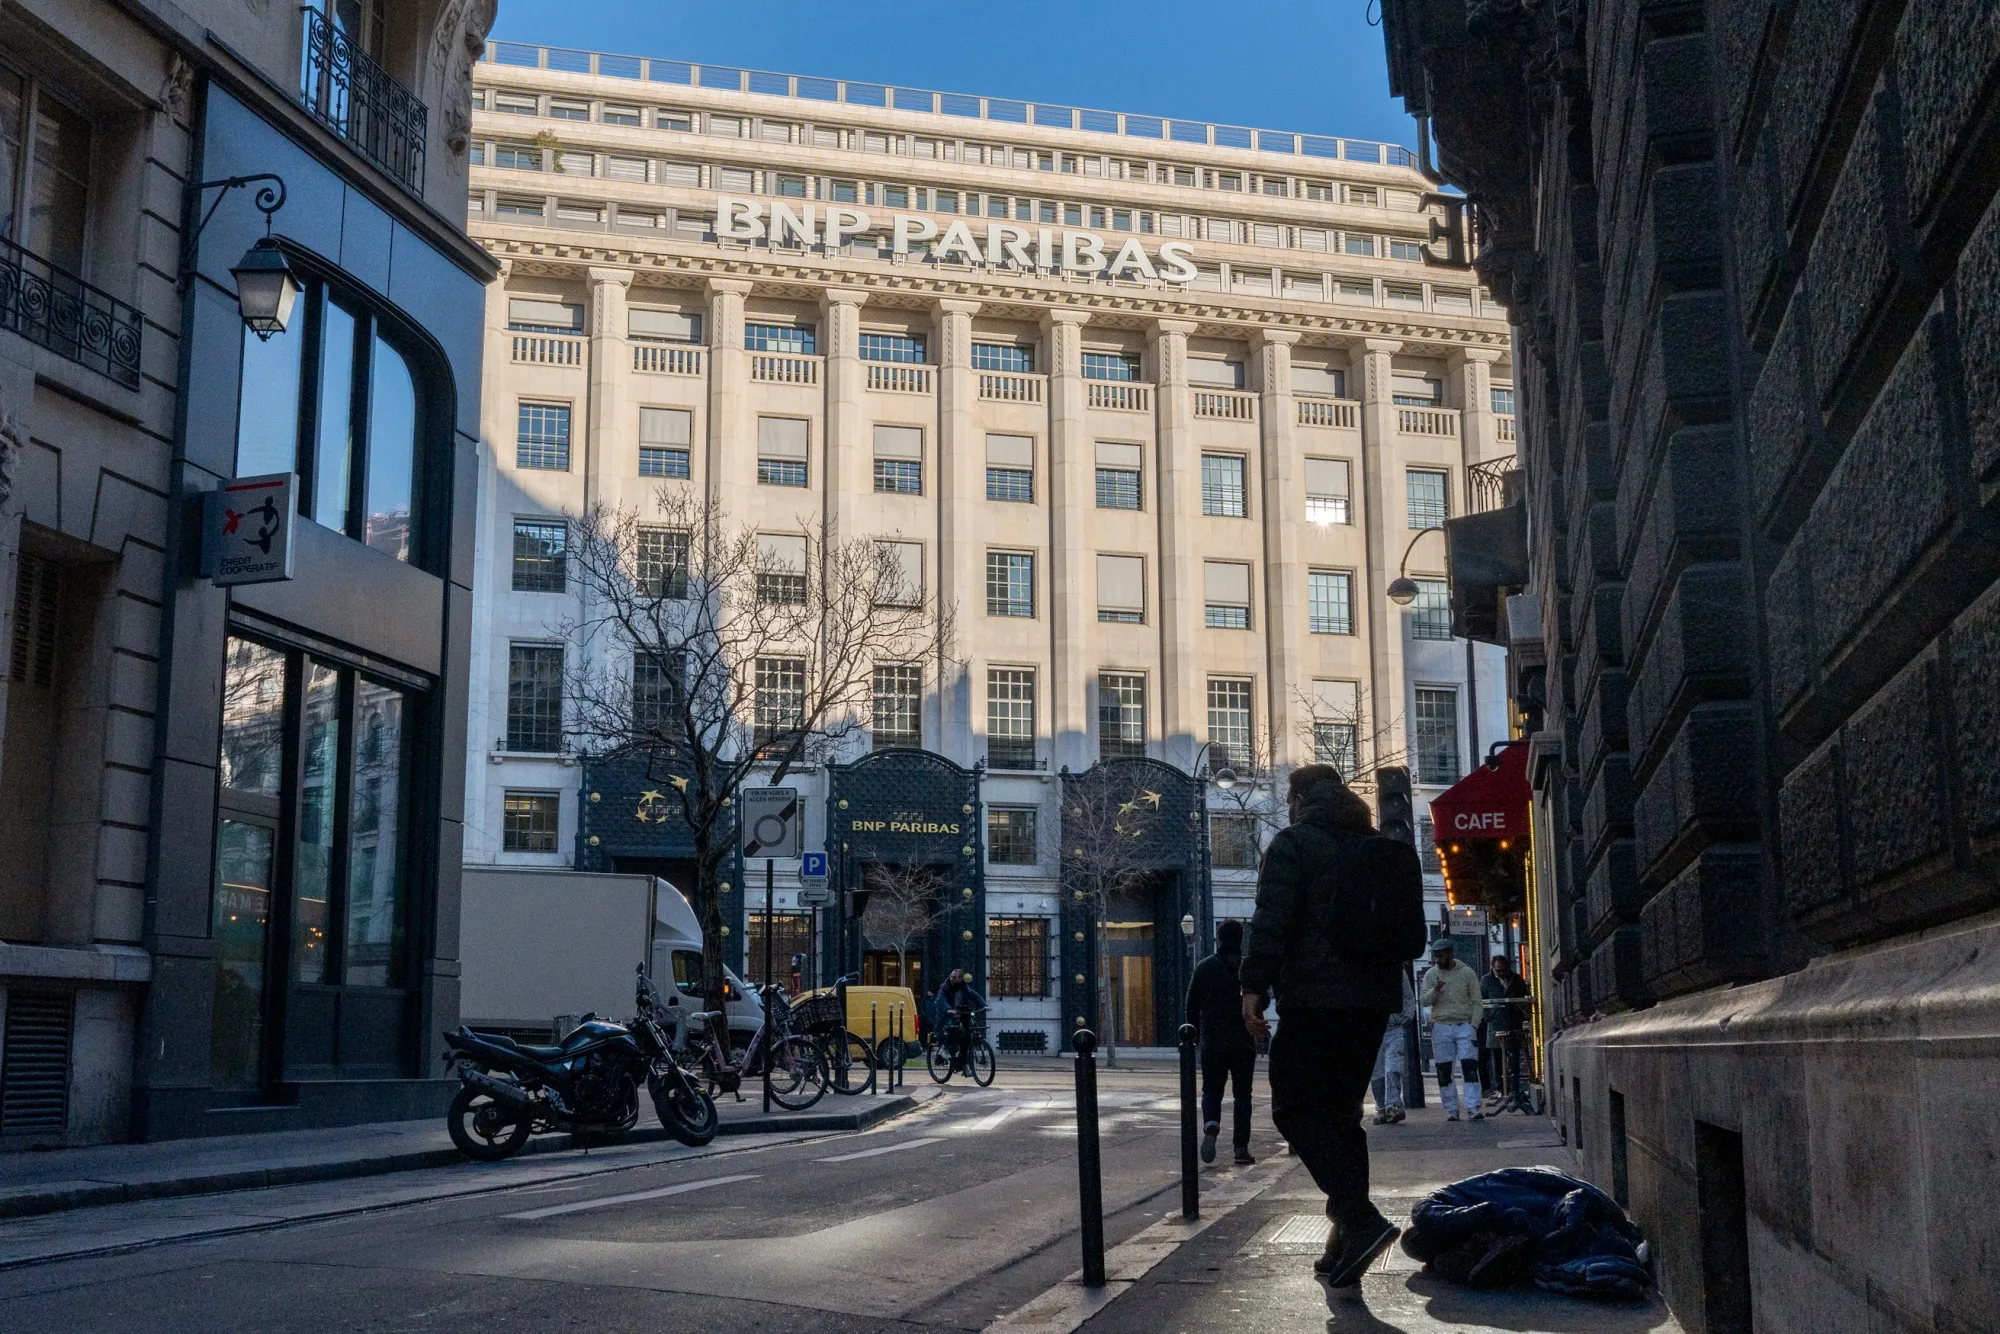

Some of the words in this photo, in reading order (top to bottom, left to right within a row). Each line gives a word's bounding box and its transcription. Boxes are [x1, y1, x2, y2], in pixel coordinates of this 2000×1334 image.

[716, 195, 871, 248] BNP
[892, 213, 1198, 284] PARIBAS
[852, 820, 886, 832] BNP
[890, 821, 960, 834] PARIBAS
[1454, 812, 1506, 831] CAFE
[809, 857, 821, 872] P
